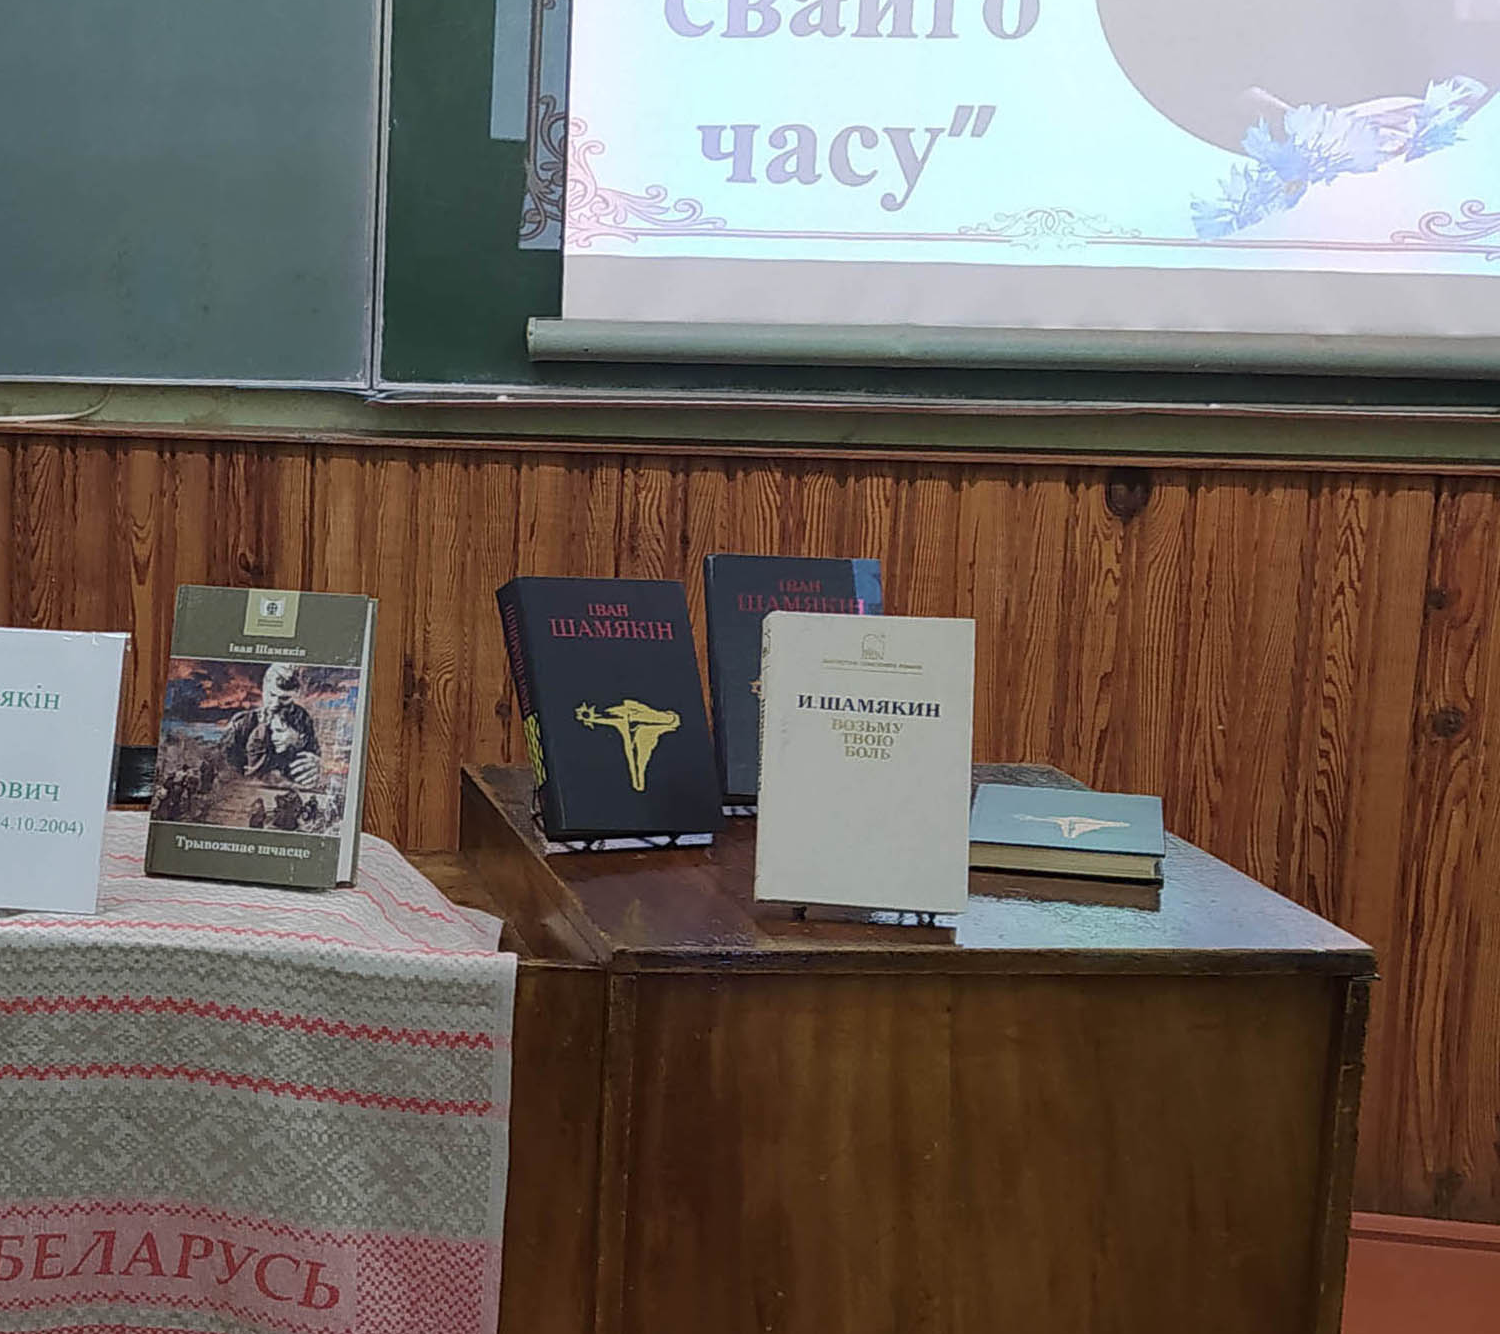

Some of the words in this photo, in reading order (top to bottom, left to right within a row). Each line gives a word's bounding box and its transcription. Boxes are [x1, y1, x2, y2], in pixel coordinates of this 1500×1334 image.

[778, 579, 822, 593] ІВАН
[588, 603, 629, 617] ІВАН
[549, 618, 674, 640] ШАМЯКІН
[229, 642, 253, 653] Іван
[255, 644, 307, 657] Шамякін
[831, 718, 904, 735] ВОЗЬМУ
[843, 732, 894, 748] ТВОЮ
[845, 745, 891, 760] БОЛЬ
[175, 835, 256, 854] Трывожнае
[258, 844, 311, 860] шчасце
